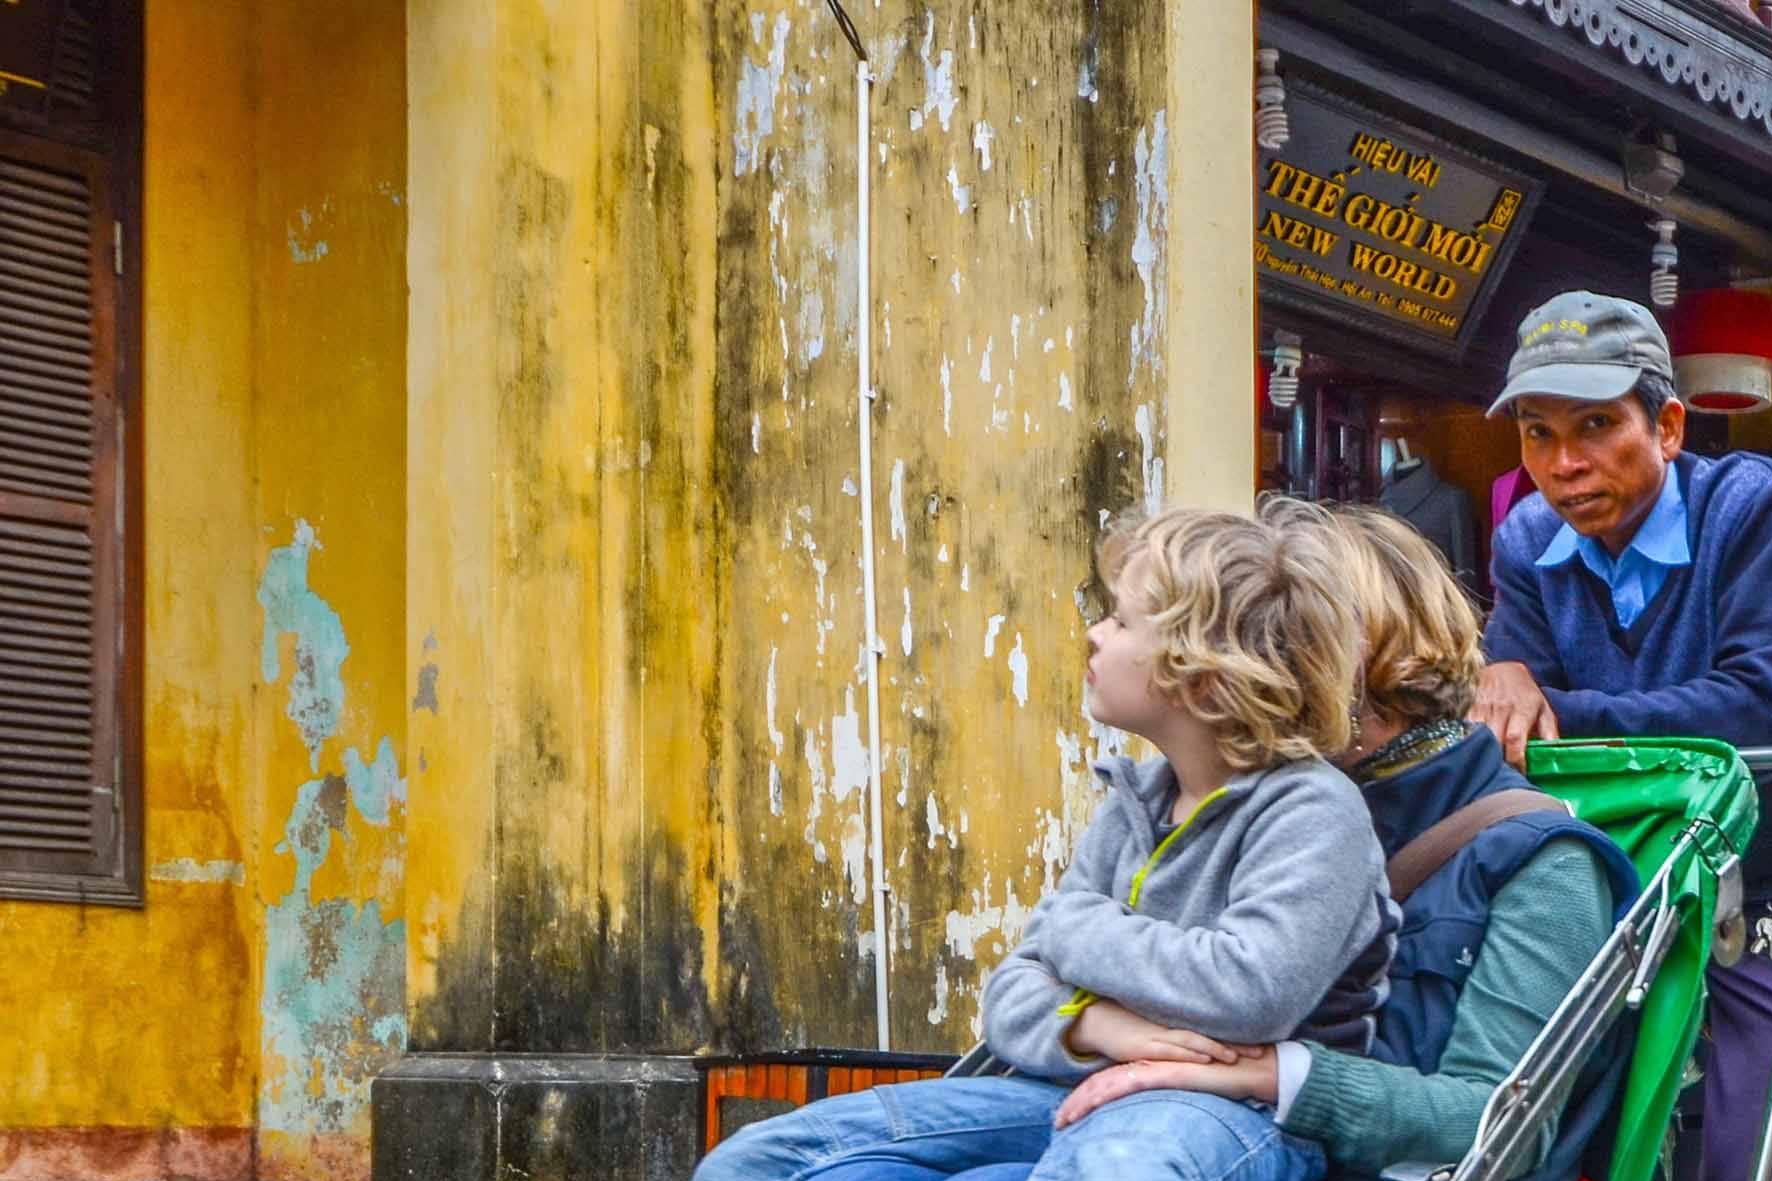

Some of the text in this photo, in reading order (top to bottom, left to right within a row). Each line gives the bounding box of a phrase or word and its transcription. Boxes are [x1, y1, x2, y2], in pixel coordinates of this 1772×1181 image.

[1351, 132, 1406, 174] HIỆU
[1260, 211, 1456, 301] NEW WORLD
[1264, 160, 1361, 219] THẾ
[1344, 193, 1425, 249] GIỚI
[1421, 222, 1492, 275] MỚI
